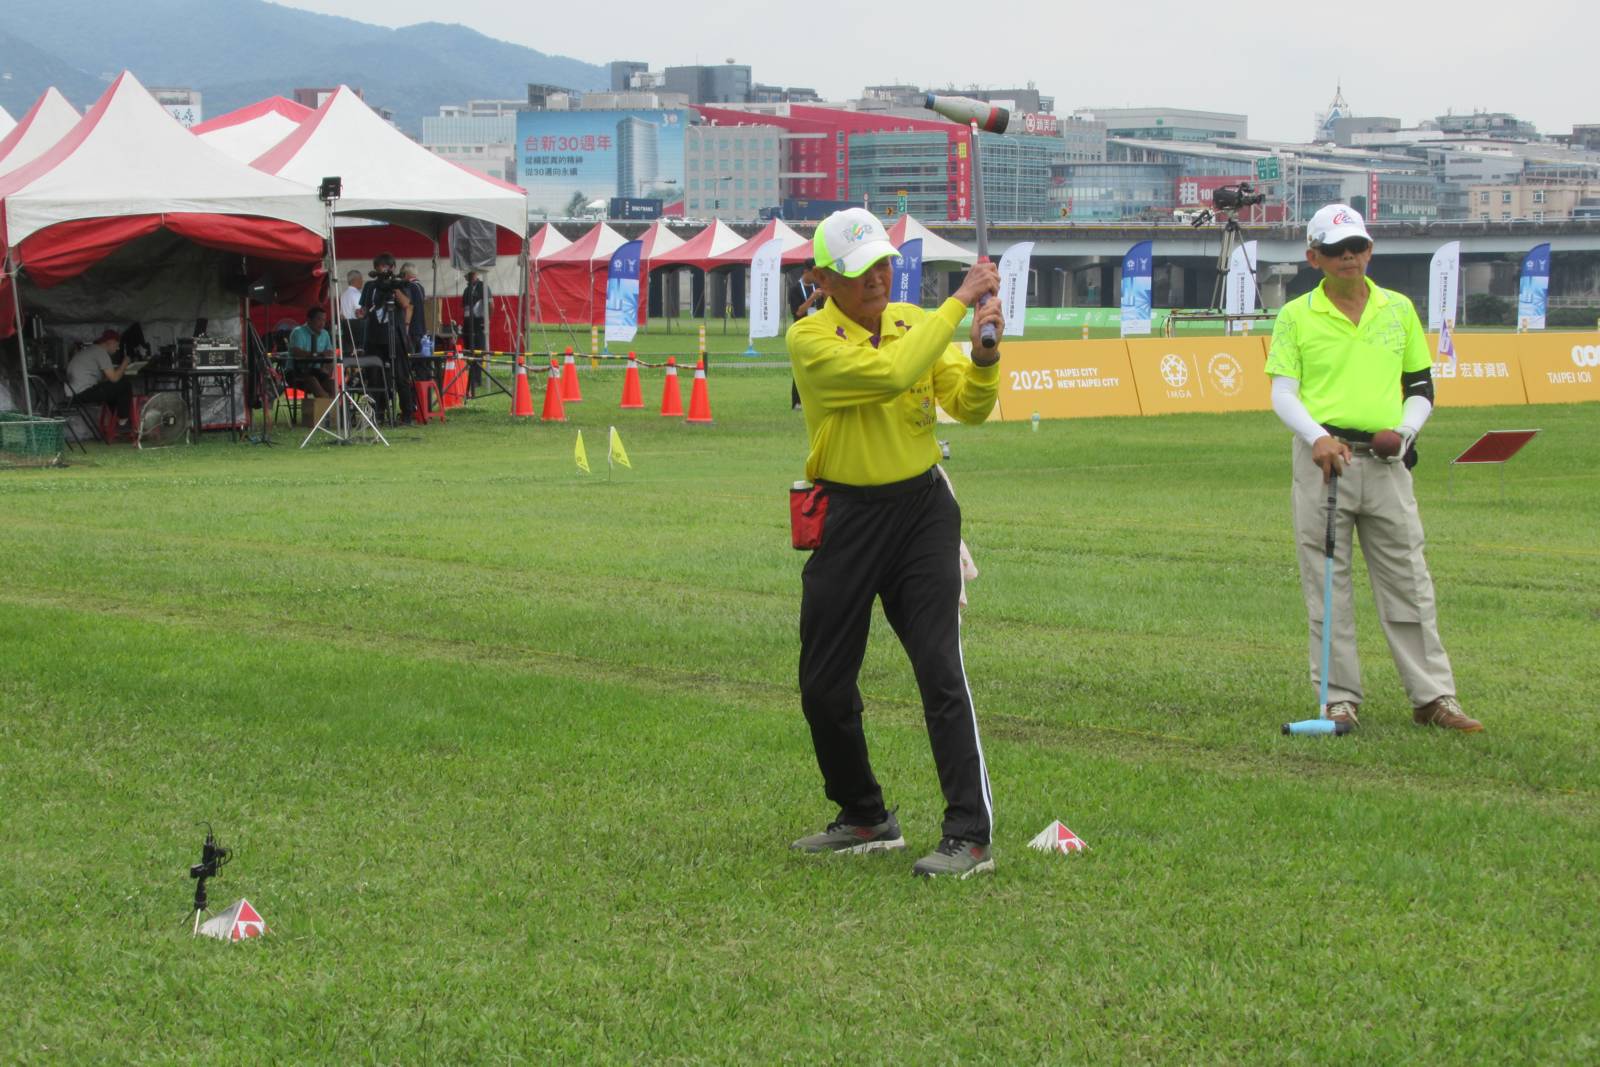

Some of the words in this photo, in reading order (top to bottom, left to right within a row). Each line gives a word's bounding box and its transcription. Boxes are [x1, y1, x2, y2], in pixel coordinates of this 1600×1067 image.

[525, 135, 612, 151] 台新30週年
[1178, 182, 1200, 205] 租
[1055, 368, 1080, 377] TAIPEI
[1081, 367, 1097, 376] CITY
[1546, 371, 1575, 384] TAIPEI
[1010, 370, 1053, 390] 2025
[1057, 380, 1075, 389] NEW
[1076, 378, 1102, 388] TAIPEI
[1103, 377, 1120, 387] CITY
